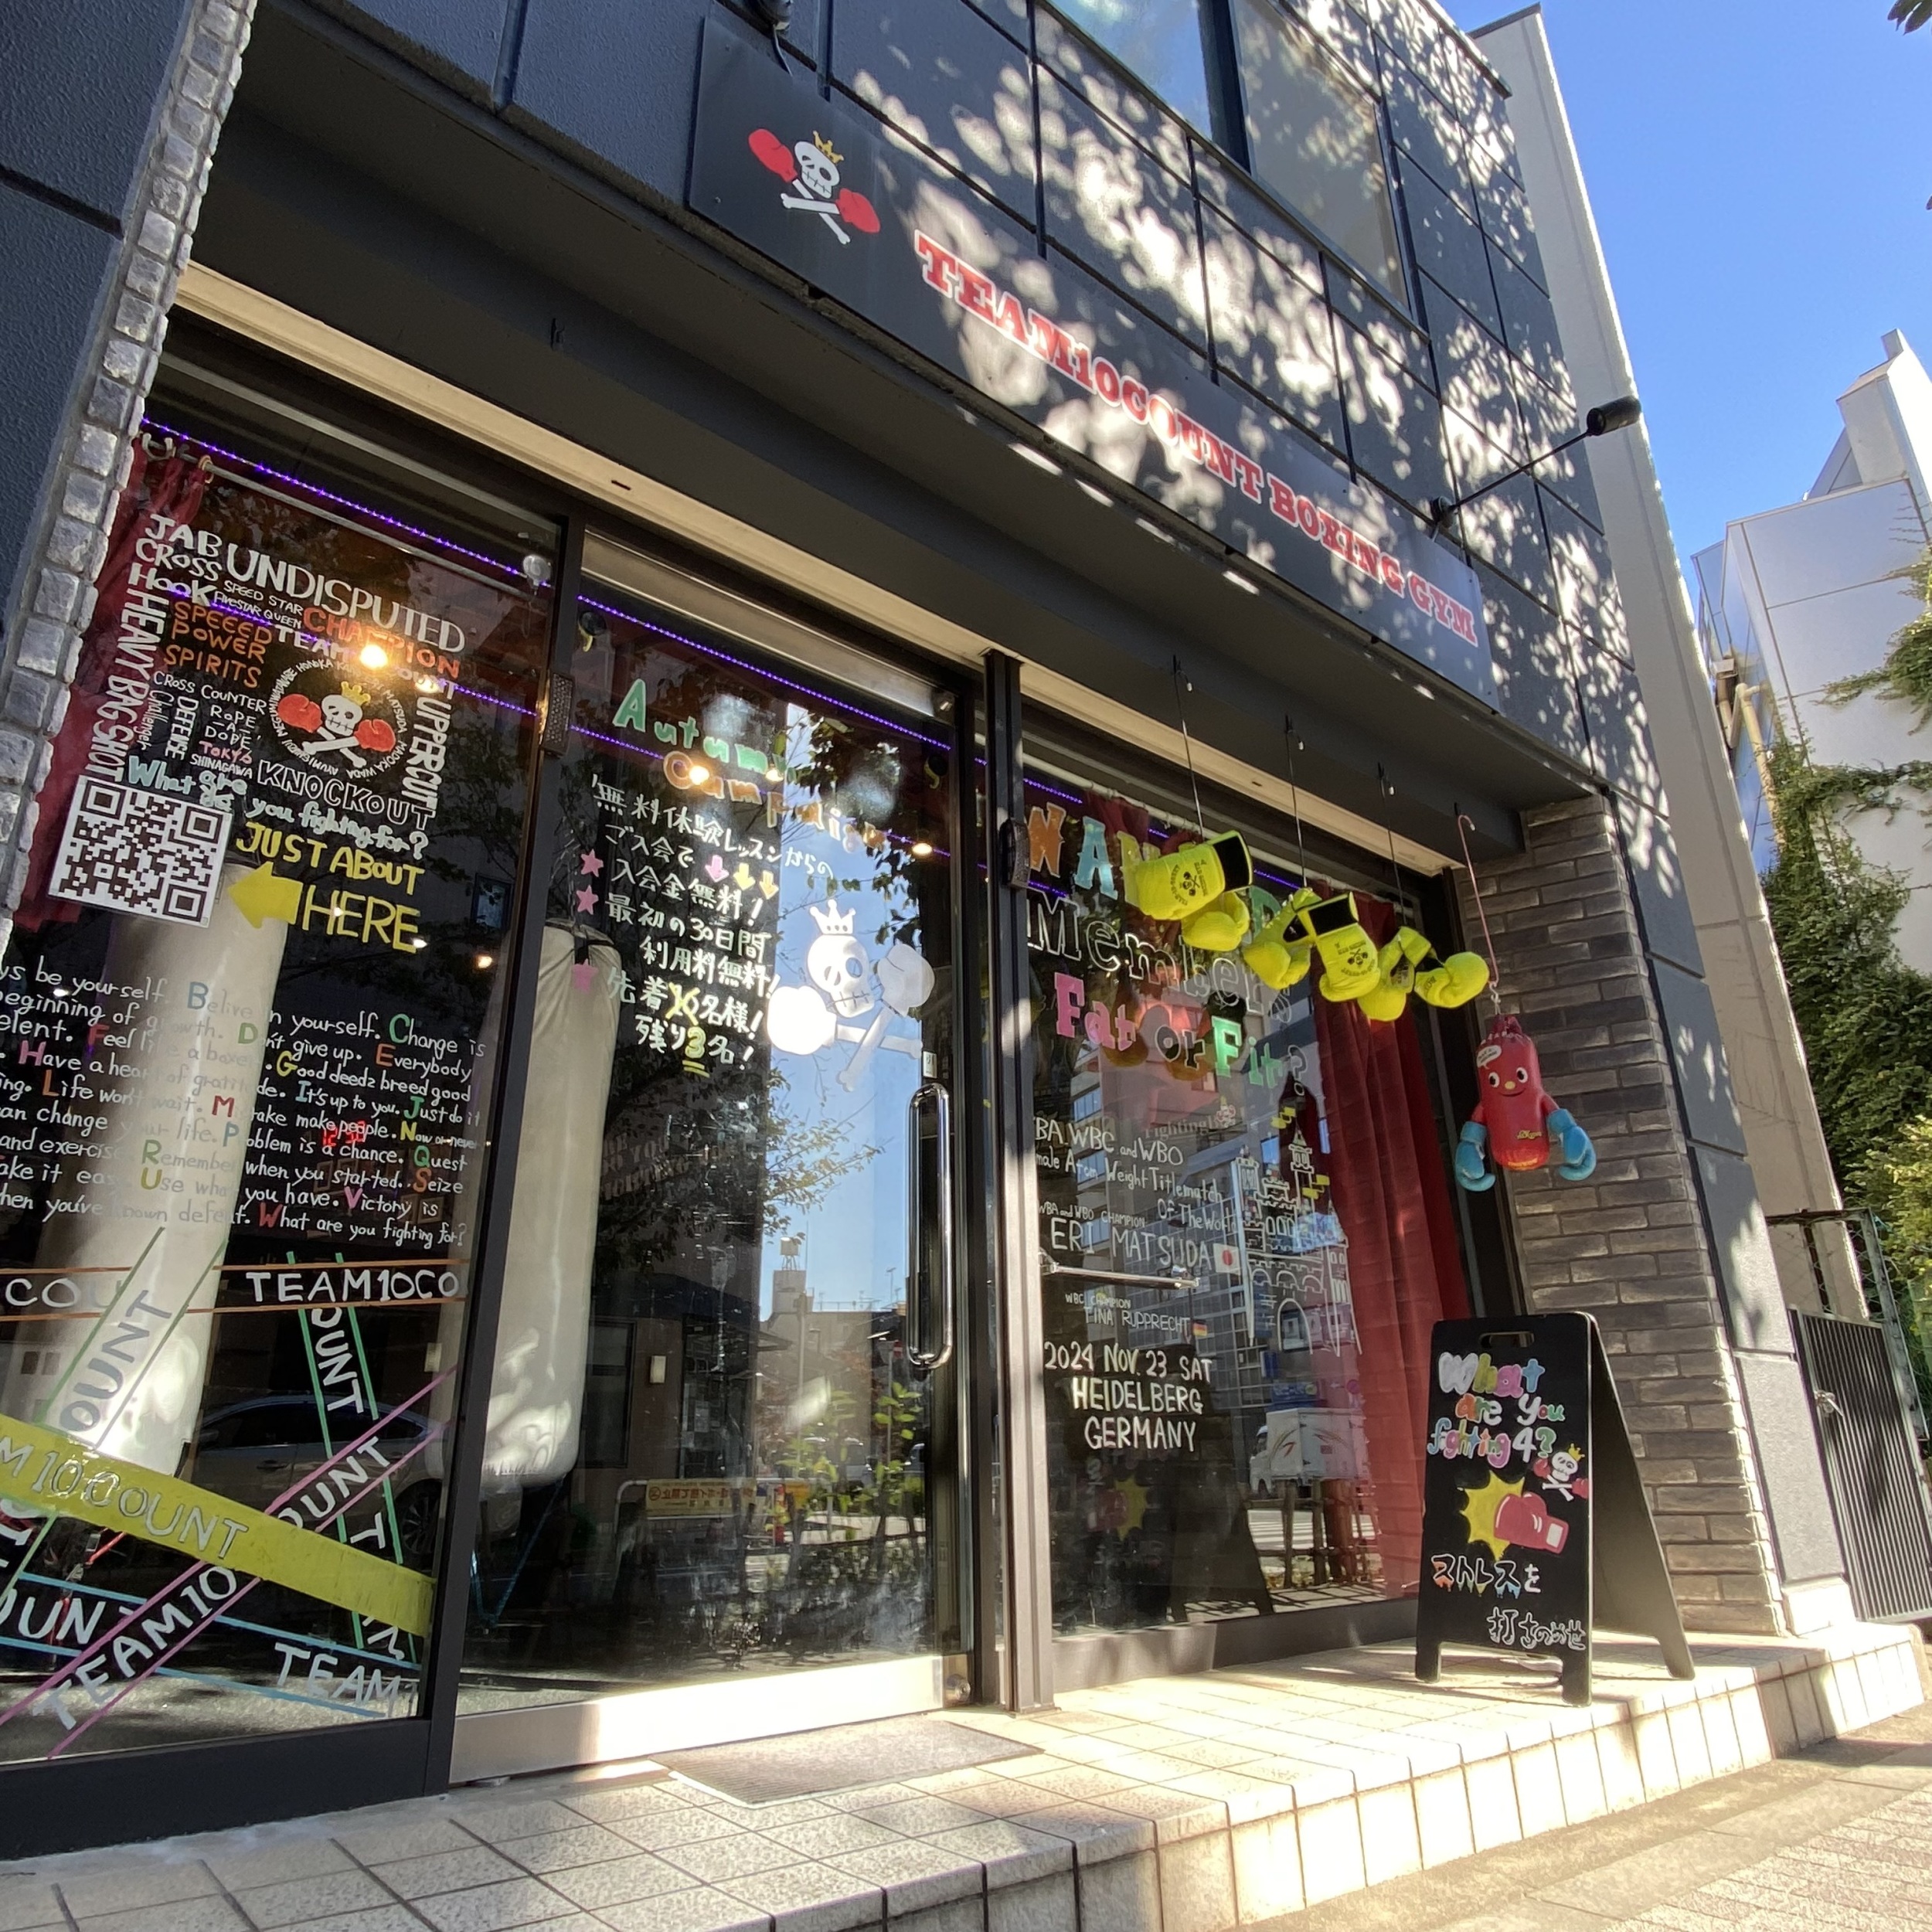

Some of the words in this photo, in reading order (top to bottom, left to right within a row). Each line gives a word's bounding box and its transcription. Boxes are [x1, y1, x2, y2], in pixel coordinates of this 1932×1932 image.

[136, 539, 223, 580] CROSS
[145, 514, 223, 557] JAB
[1267, 473, 1405, 599] BOXING
[1406, 571, 1479, 648] GYM
[128, 563, 217, 607] HOOK
[223, 580, 264, 600] SPEED
[269, 595, 304, 616] STAR
[226, 543, 465, 652] UNDISPUTED
[115, 588, 169, 680] HEAVY
[172, 621, 266, 664] POWER
[264, 610, 301, 629] QUEEN
[304, 607, 461, 679] CHAMPION
[164, 645, 261, 689] SPIRITS
[97, 675, 150, 723] BAG
[154, 671, 196, 693] CROSS
[201, 685, 267, 715] COUNTER
[383, 689, 407, 733] MATSUDA
[85, 720, 134, 783] SHOT
[165, 696, 199, 760] DEFENSE
[401, 696, 452, 811] UPPERCUT
[128, 755, 196, 794] What
[245, 798, 294, 823] you
[190, 753, 253, 779] SHINAGAWA
[257, 760, 435, 831] KNOCKOUT
[236, 821, 328, 868] JUST
[330, 847, 424, 895] ABOUT
[605, 824, 696, 869] ご入会で
[302, 885, 421, 953] HERE
[36, 955, 62, 985] be
[291, 1011, 380, 1039] yourself.
[389, 1014, 458, 1060] Change
[469, 1039, 486, 1056] is
[1054, 971, 1136, 1051] Fat
[88, 1024, 137, 1049] Feel
[276, 1051, 328, 1080] Good
[380, 1070, 429, 1096] breed
[431, 1085, 471, 1106] good
[113, 1002, 140, 1025] of
[292, 1039, 328, 1062] give
[376, 1043, 471, 1082] Everybody
[19, 1040, 82, 1071] Have
[90, 1060, 104, 1073] a
[295, 1080, 328, 1106] It's
[330, 1097, 348, 1114] up
[353, 1094, 366, 1110] to
[403, 1096, 448, 1123] Just
[449, 1104, 462, 1123] do
[42, 1069, 94, 1100] Life
[296, 1111, 335, 1132] make
[400, 1121, 433, 1143] Now
[0, 1128, 37, 1152] and
[246, 1154, 289, 1179] when
[292, 1165, 323, 1186] you
[413, 1167, 463, 1192] Seize
[37, 1100, 108, 1137] change
[299, 1138, 315, 1154] is
[322, 1145, 334, 1156] a
[340, 1140, 404, 1164] chance.
[413, 1145, 468, 1171] Quest
[1069, 1123, 1114, 1153] WBC
[1121, 1140, 1138, 1158] and
[1138, 1138, 1183, 1165] WBO
[0, 1156, 34, 1181] ake
[42, 1163, 63, 1182] it
[141, 1167, 184, 1192] Use
[243, 1187, 278, 1209] you
[285, 1182, 338, 1207] have.
[344, 1185, 412, 1219] Victory
[422, 1202, 438, 1216] is
[1105, 1157, 1148, 1191] Weight
[0, 1183, 33, 1210] hen
[259, 1202, 311, 1228] What
[317, 1217, 342, 1233] are
[349, 1223, 376, 1241] you
[383, 1217, 434, 1250] fighting
[1060, 1205, 1073, 1218] and
[1075, 1206, 1094, 1221] WBO
[1101, 1211, 1145, 1228] CHAMPION
[1051, 1217, 1095, 1254] ERI
[1112, 1226, 1213, 1270] MATSUDA
[1065, 1294, 1083, 1305] WBC
[1090, 1295, 1131, 1309] CHAMPION
[1083, 1306, 1114, 1326] TINA
[1122, 1310, 1191, 1333] RUPPRECHT
[60, 1289, 172, 1433] OUNT
[1044, 1341, 1094, 1371] 2024
[1145, 1350, 1167, 1378] 23
[1179, 1355, 1213, 1384] SAT
[1438, 1352, 1546, 1398] What
[1072, 1376, 1204, 1415] HEIDELBERG
[1455, 1393, 1502, 1426] are
[1517, 1393, 1566, 1427] you
[1084, 1416, 1196, 1452] GERMANY
[1427, 1417, 1512, 1468] fighting
[1430, 1553, 1542, 1600] ストレスを
[32, 1566, 237, 1730] TEAM10
[1487, 1607, 1586, 1651] 打ちのめせ
